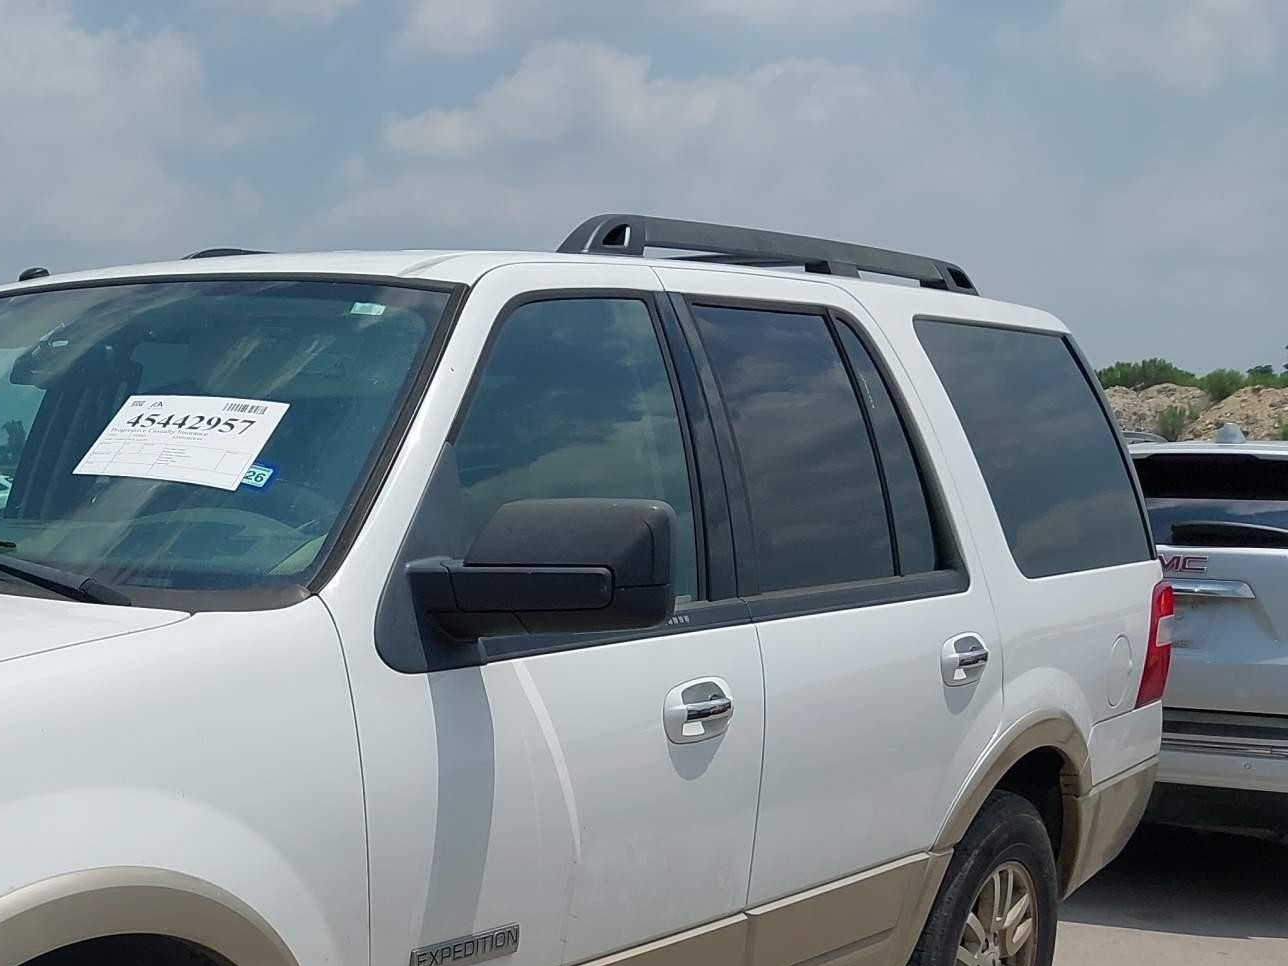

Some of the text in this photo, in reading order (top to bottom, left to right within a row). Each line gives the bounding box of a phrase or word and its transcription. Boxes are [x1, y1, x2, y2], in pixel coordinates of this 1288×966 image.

[126, 413, 256, 435] 45442957
[244, 470, 266, 482] 26
[1157, 554, 1208, 572] MC
